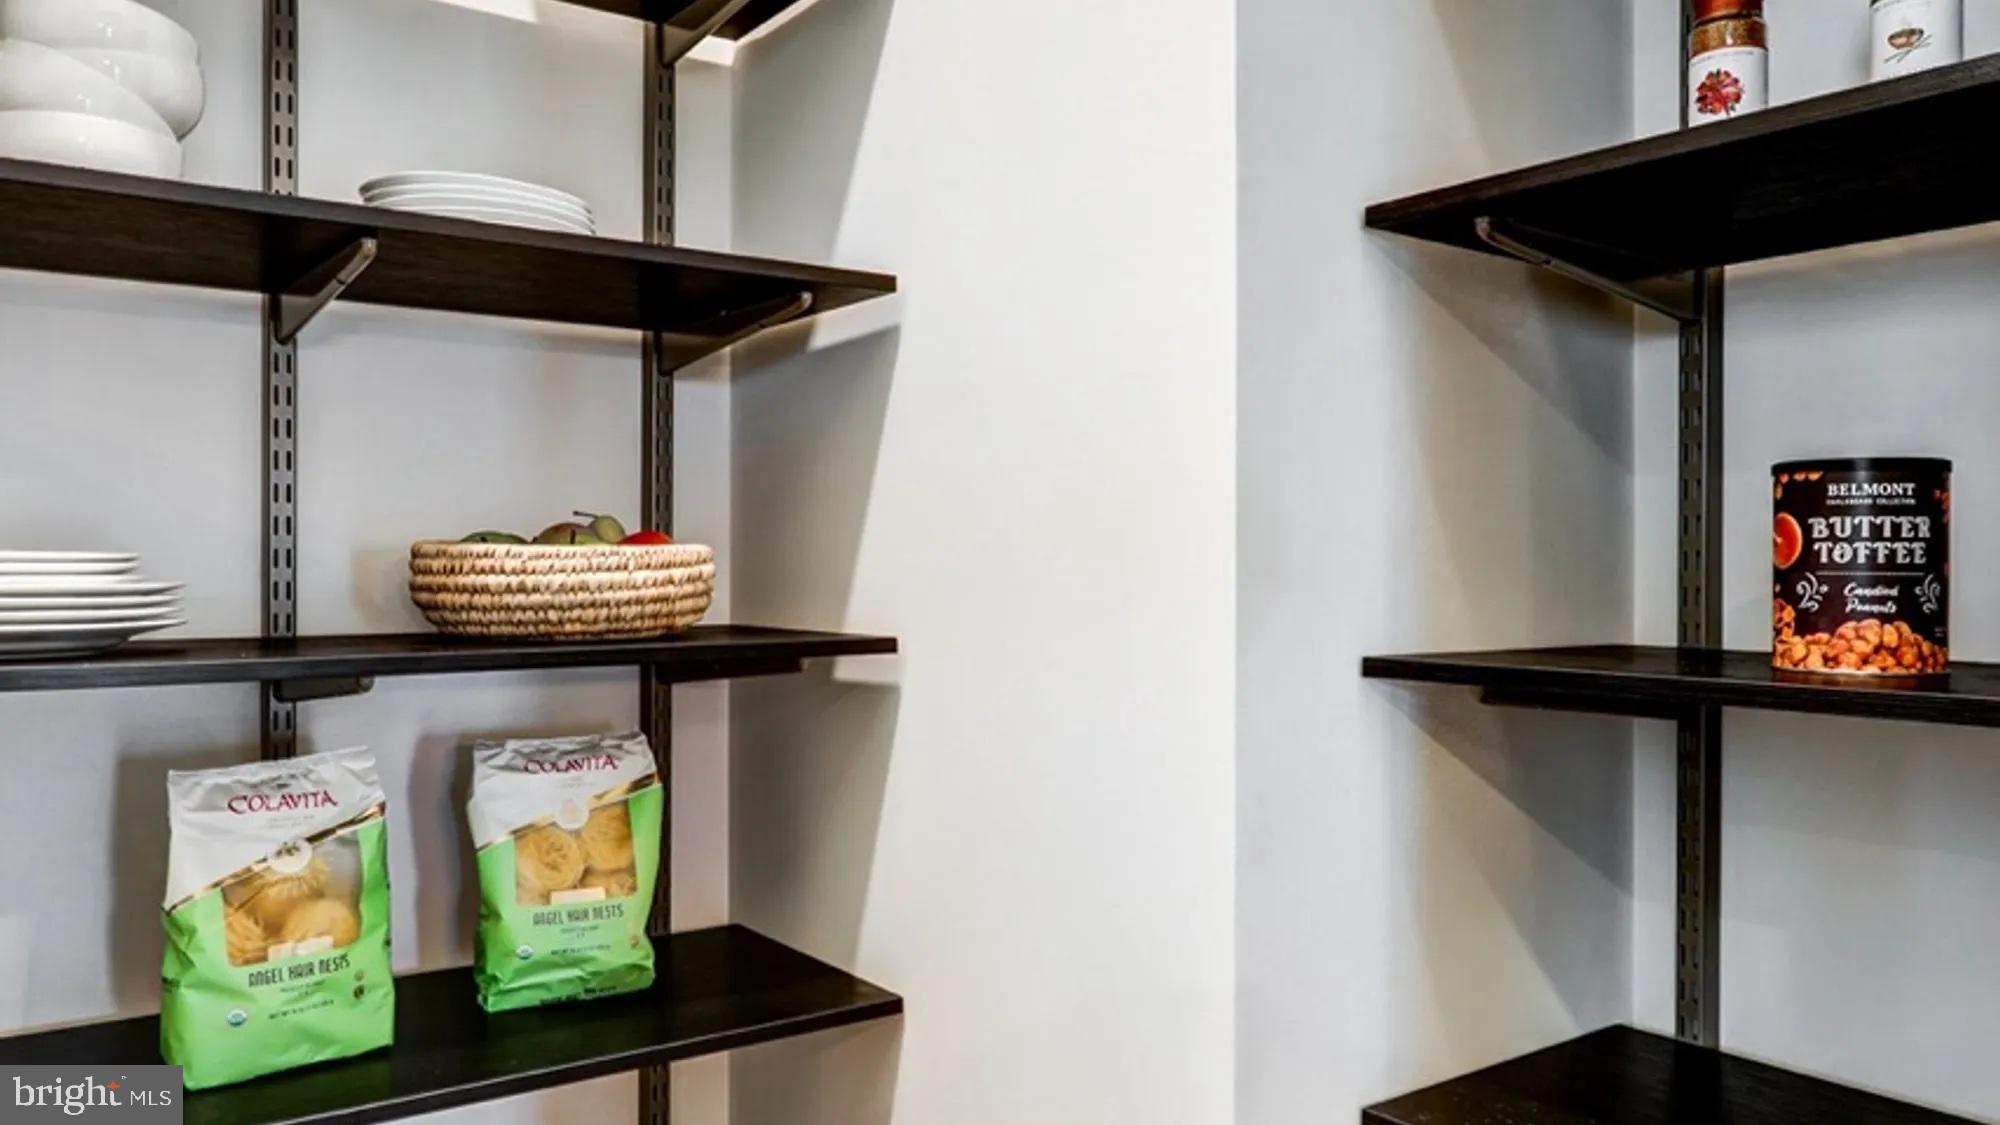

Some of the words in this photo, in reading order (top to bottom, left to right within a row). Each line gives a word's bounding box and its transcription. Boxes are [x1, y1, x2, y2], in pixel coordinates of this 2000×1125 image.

[1827, 482, 1916, 496] BELMONT
[1808, 516, 1931, 538] BUTTER
[1813, 542, 1927, 564] TOFFEE
[1843, 582, 1899, 597] Candied
[1845, 597, 1897, 613] Peanuts
[524, 754, 618, 774] COLAVITA
[228, 790, 338, 814] COLAVITA
[533, 911, 564, 926] ANGEL
[567, 906, 590, 921] HAIR
[593, 903, 624, 919] NESTS
[248, 967, 283, 988] ANGEL
[288, 961, 315, 980] HAIR
[318, 952, 351, 973] NESTS
